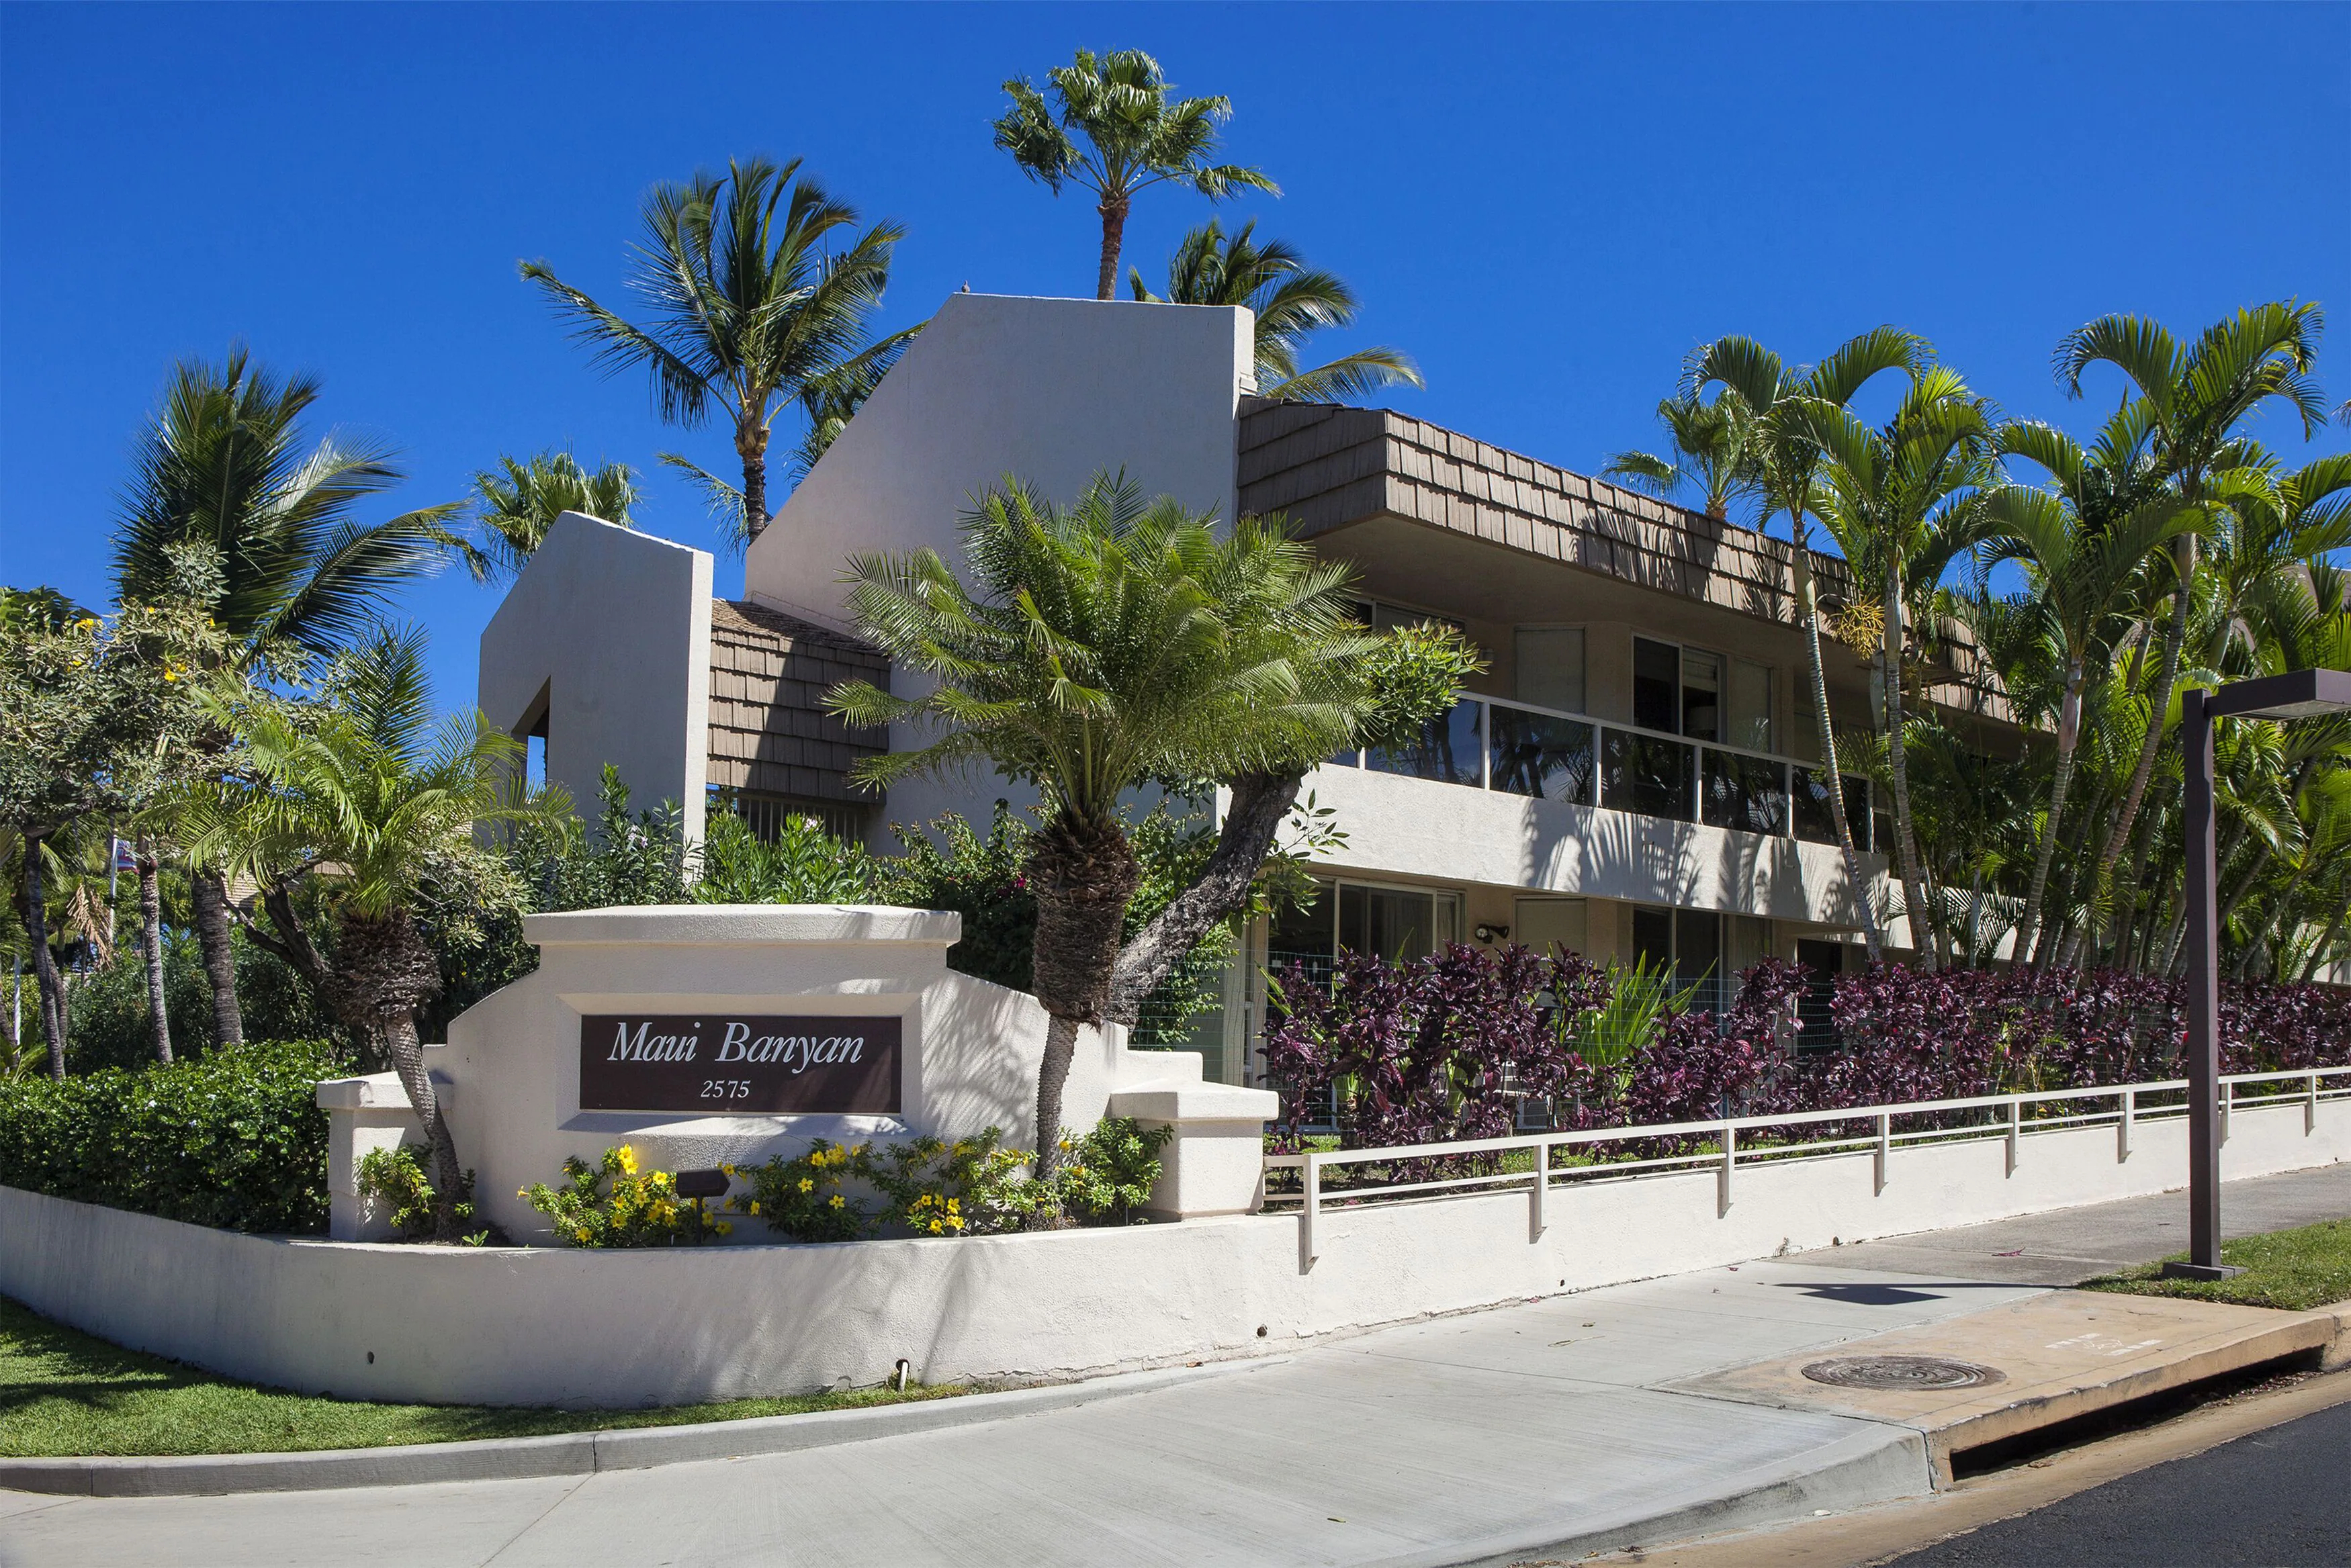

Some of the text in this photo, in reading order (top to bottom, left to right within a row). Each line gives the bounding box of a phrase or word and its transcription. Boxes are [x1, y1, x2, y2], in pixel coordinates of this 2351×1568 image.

[607, 1021, 865, 1074] Maui Banyan
[700, 1080, 751, 1099] 2575
